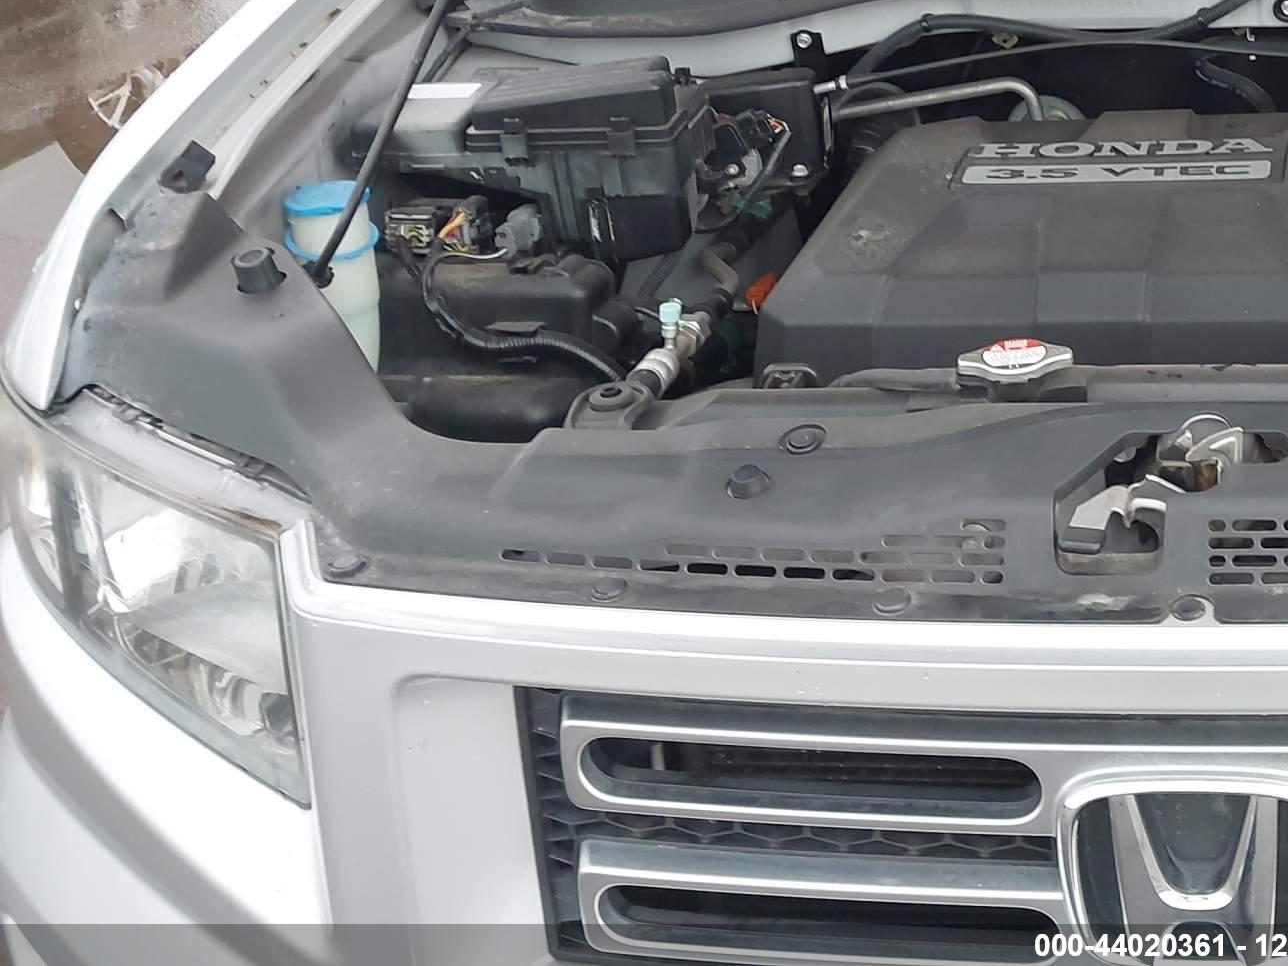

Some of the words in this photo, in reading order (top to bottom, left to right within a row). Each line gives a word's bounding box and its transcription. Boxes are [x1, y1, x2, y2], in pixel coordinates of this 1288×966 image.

[969, 137, 1274, 158] HONDA
[984, 166, 1080, 181] 3.5
[1101, 163, 1252, 179] VTEC
